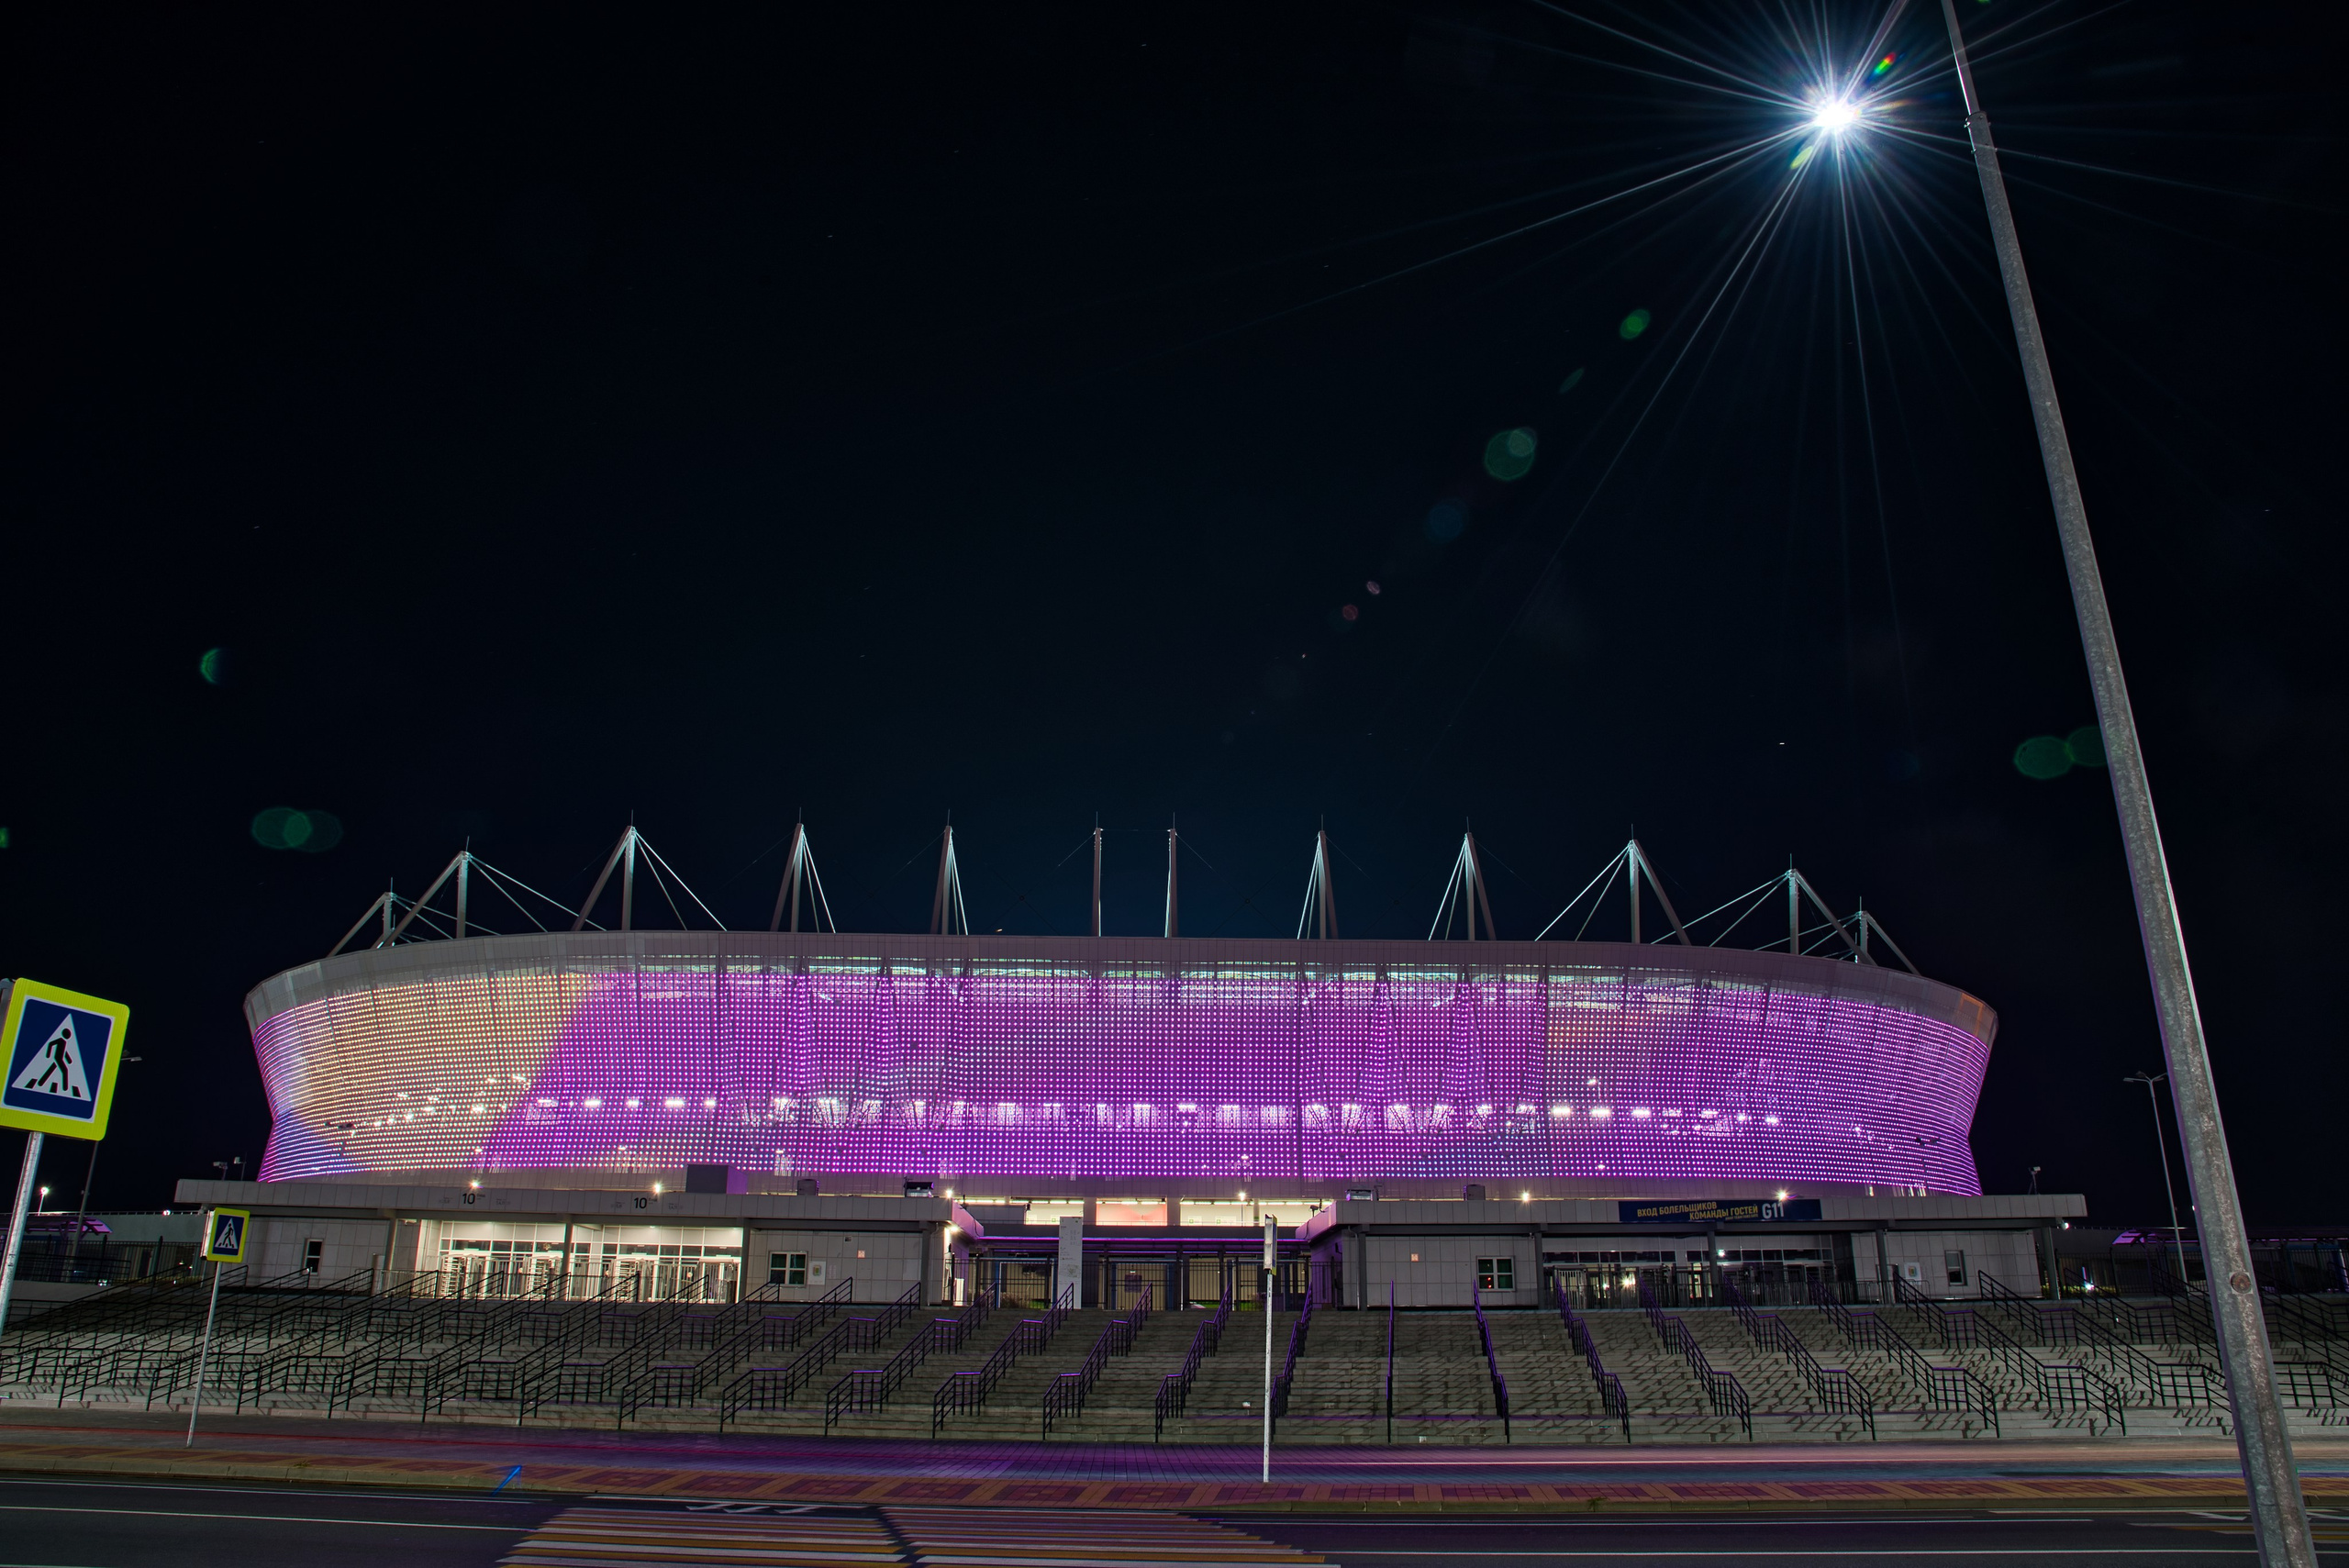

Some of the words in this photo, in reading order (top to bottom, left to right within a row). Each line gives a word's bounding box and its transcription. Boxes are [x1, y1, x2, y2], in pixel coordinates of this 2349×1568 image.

[462, 1193, 475, 1205] 10
[634, 1197, 647, 1209] 10
[1637, 1207, 1658, 1218] ВХОД
[1659, 1201, 1718, 1215] БОЛЕЛЬЩИКОВ
[1689, 1208, 1729, 1220] КОМАНДЫ
[1731, 1204, 1759, 1216] ГОСТЕЙ
[1762, 1202, 1785, 1219] G11
